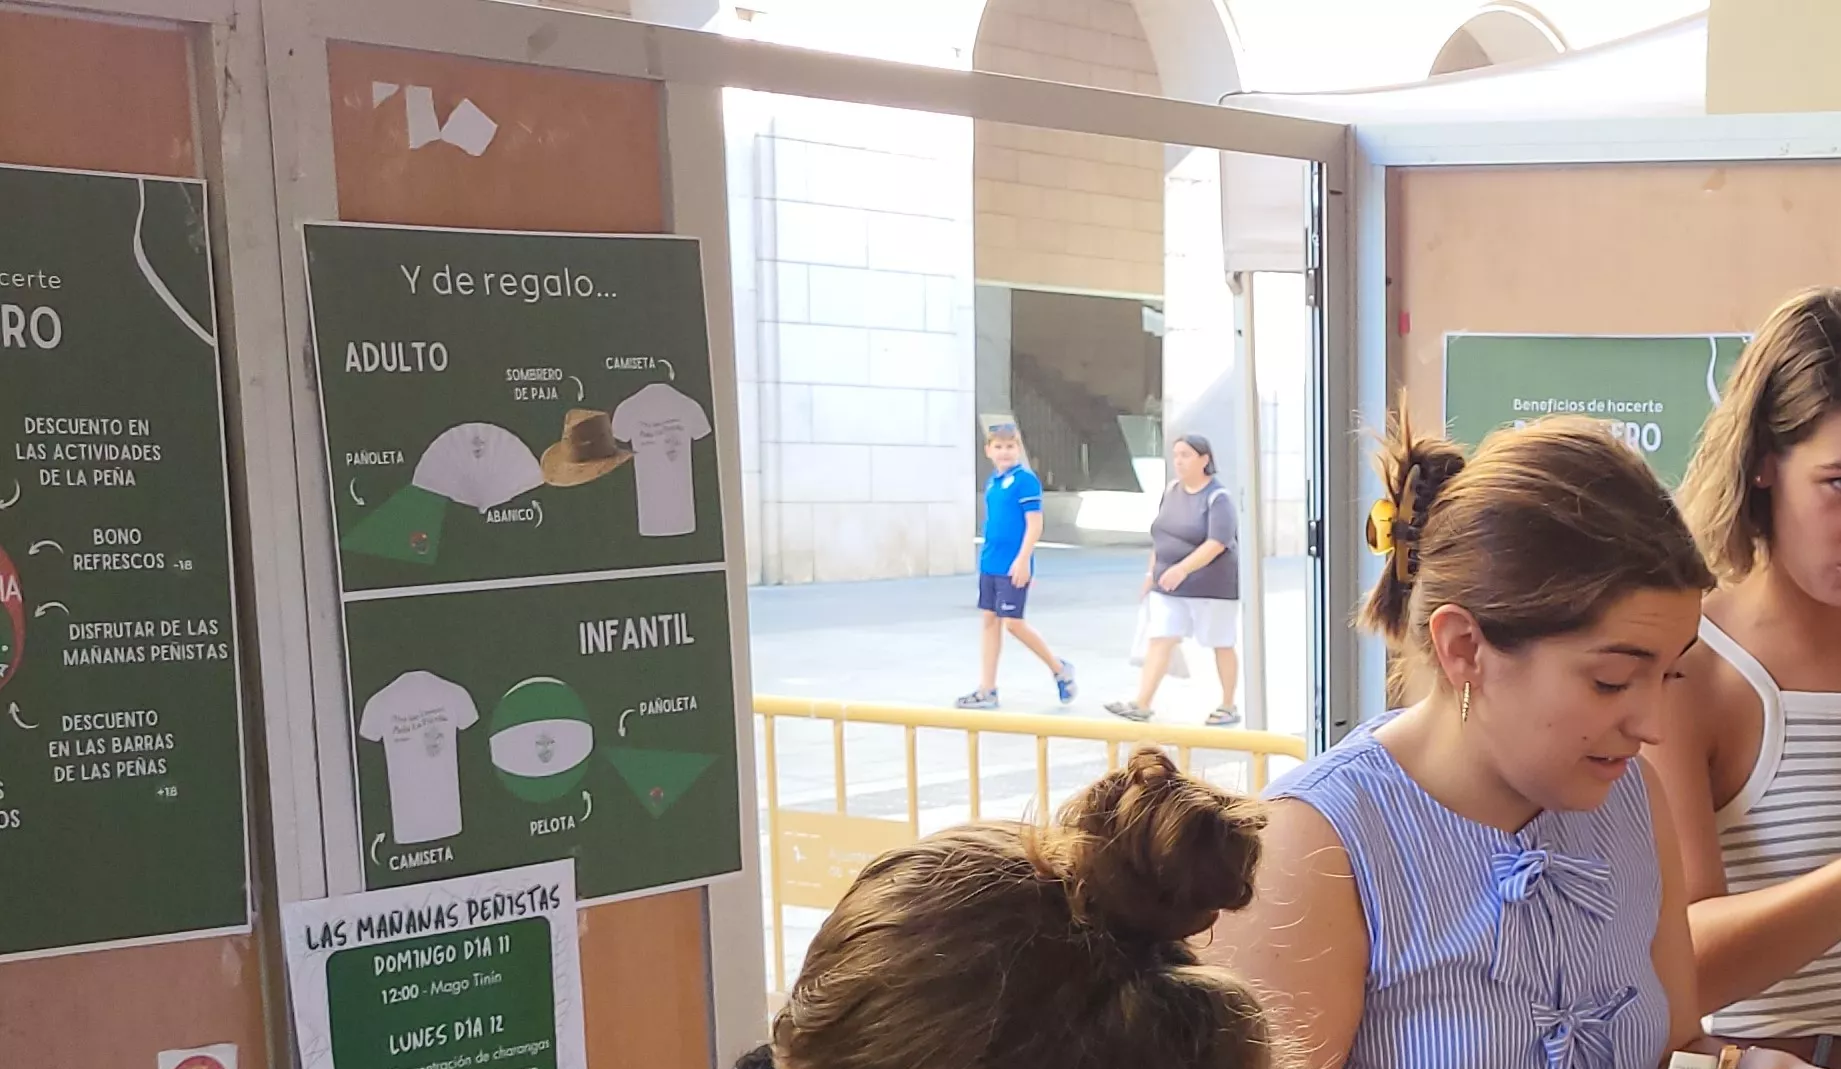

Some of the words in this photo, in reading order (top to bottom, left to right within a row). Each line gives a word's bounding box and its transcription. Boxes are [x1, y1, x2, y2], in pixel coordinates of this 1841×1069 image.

[400, 264, 421, 294] Y
[433, 265, 475, 296] de
[485, 267, 617, 302] regalo...
[2, 304, 62, 349] RO
[345, 342, 448, 373] ADULTO
[606, 357, 656, 370] CAMISETA
[506, 368, 563, 382] SOMBRERO
[514, 387, 528, 400] DE
[532, 386, 558, 400] PAJA
[1513, 398, 1585, 413] Beneficios
[1588, 399, 1605, 412] de
[1607, 399, 1663, 413] hacerte
[24, 417, 122, 435] DESCUENTO
[128, 418, 150, 437] EN
[16, 443, 47, 461] LAS
[53, 443, 161, 461] ACTIVIDADES
[346, 449, 404, 465] PAÑOLETA
[40, 469, 61, 486] DE
[66, 470, 87, 486] LA
[93, 465, 136, 487] PEÑA
[487, 508, 534, 523] ABANICO
[93, 528, 141, 545] BONO
[73, 553, 164, 571] REFRESCOS
[69, 620, 155, 640] DISFRUTAR
[161, 619, 181, 636] DE
[187, 619, 219, 635] LAS
[579, 612, 694, 655] INFANTIL
[63, 644, 145, 666] MAÑANAS
[151, 640, 228, 661] PEÑISTAS
[640, 696, 698, 716] PAÑOLETA
[62, 710, 158, 732] DESCUENTO
[49, 739, 70, 758] EN
[76, 738, 105, 756] LAS
[112, 733, 174, 753] BARRAS
[54, 765, 75, 783] DE
[82, 762, 111, 780] LAS
[117, 756, 167, 777] PEÑAS
[530, 815, 576, 836] PELOTA
[390, 847, 453, 871] CAMISETA
[306, 919, 347, 950] LAS
[357, 902, 459, 941] MAÑANAS
[468, 883, 560, 924] PEÑISTAS
[374, 944, 457, 976] DOMINGO
[498, 934, 511, 954] 11
[381, 983, 419, 1004] 12:00
[430, 978, 469, 997] Mago
[390, 1023, 447, 1055] LUNES
[490, 1015, 504, 1034] 12
[476, 1050, 489, 1063] de
[493, 1038, 551, 1060] charangas
